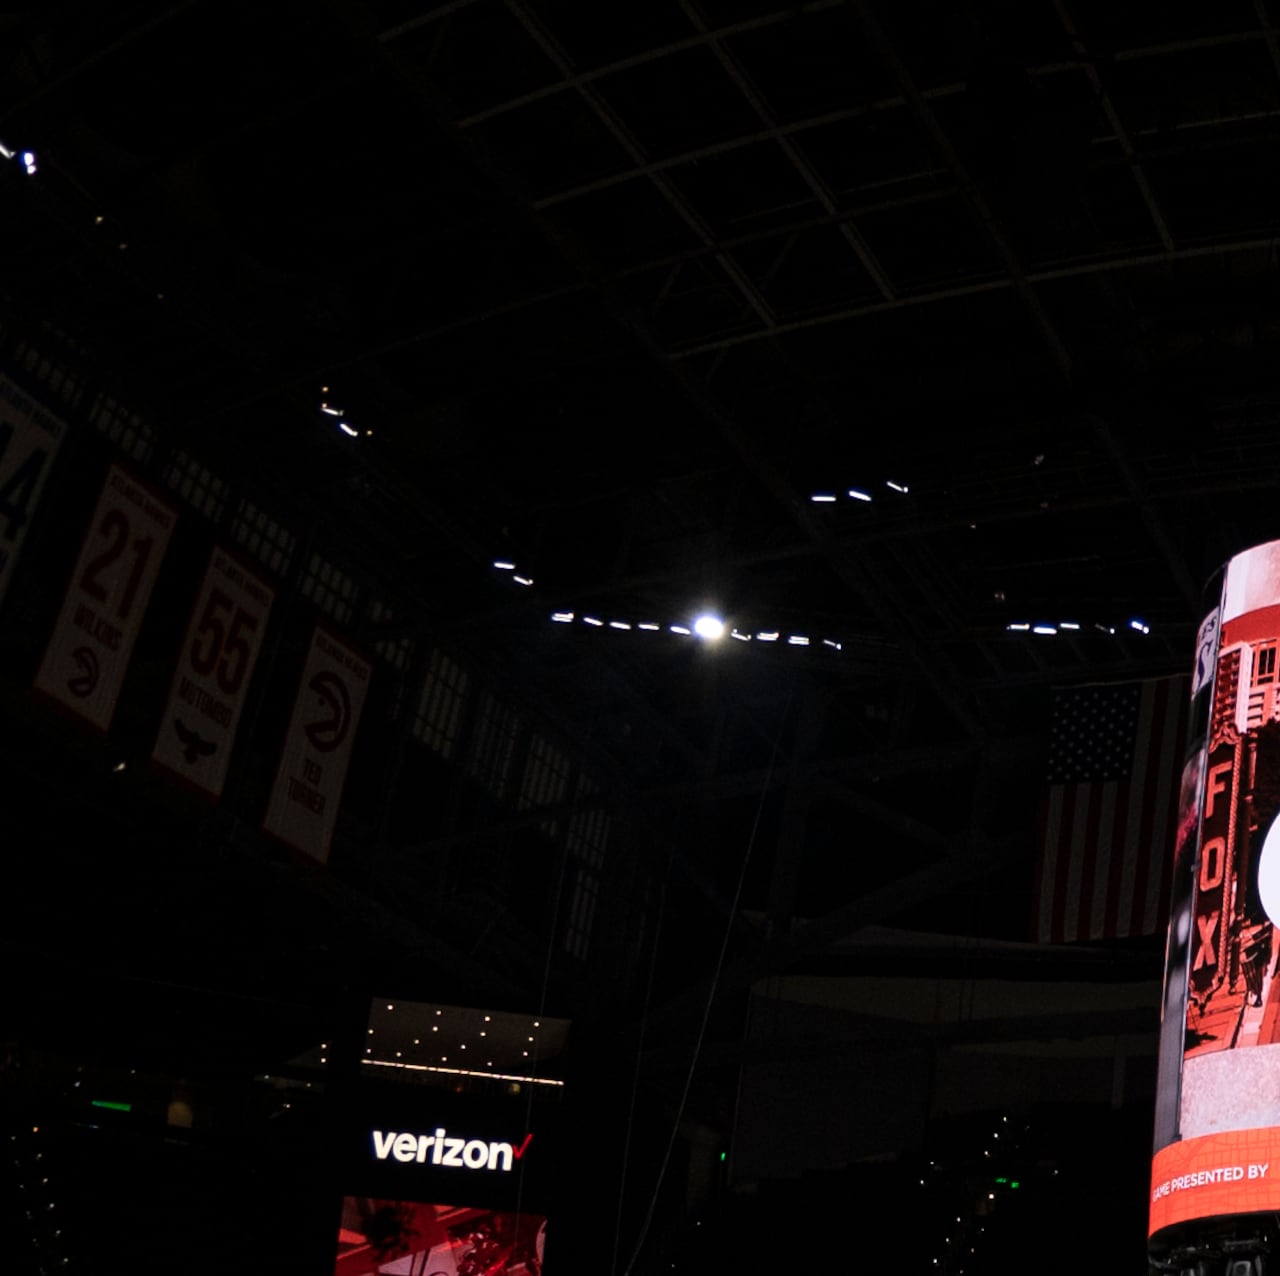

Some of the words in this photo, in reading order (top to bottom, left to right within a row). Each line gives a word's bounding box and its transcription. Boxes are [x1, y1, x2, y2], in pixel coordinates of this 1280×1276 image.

[81, 508, 153, 619] 21
[190, 589, 259, 695] 55
[1192, 760, 1234, 972] FOX
[371, 1128, 515, 1171] verizon
[1170, 1165, 1245, 1195] PRESENTED
[1247, 1163, 1269, 1179] BY
